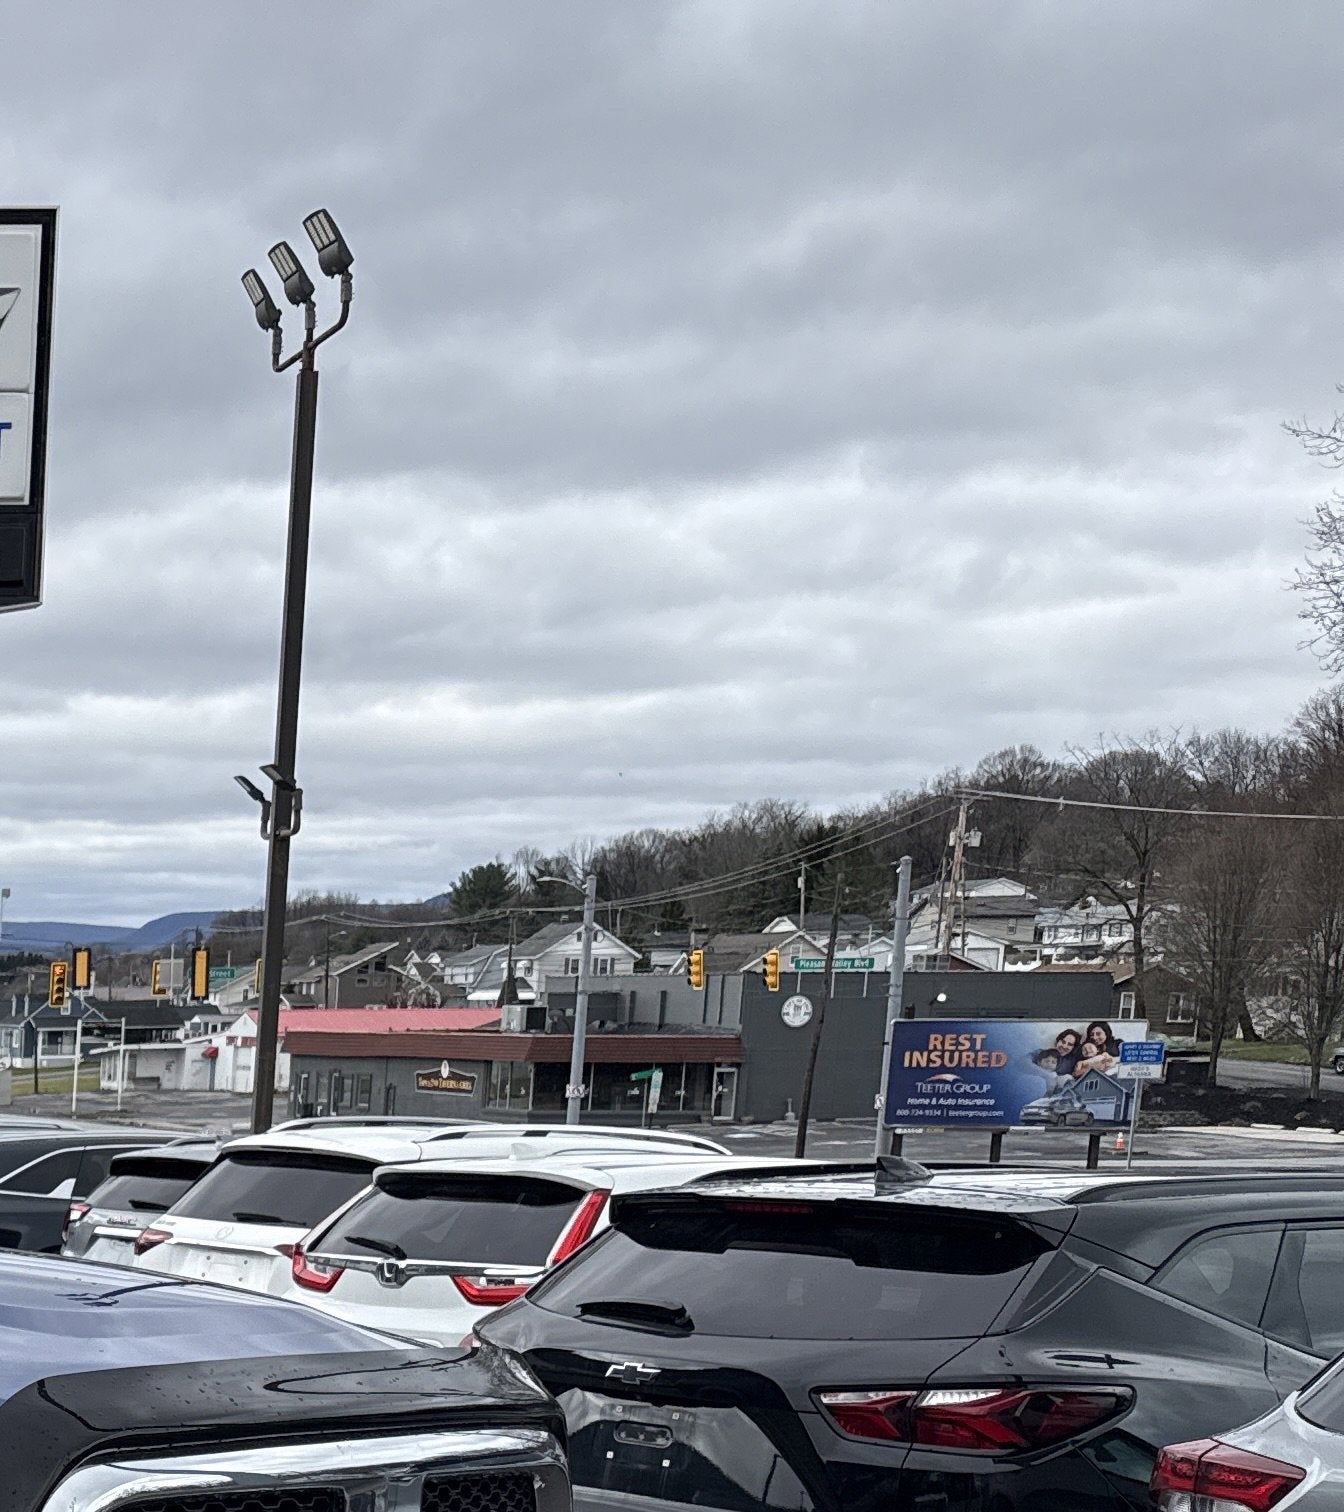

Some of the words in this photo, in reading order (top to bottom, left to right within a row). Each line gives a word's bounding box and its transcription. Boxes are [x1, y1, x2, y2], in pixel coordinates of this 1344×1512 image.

[928, 1034, 986, 1050] REST
[903, 1051, 1007, 1068] INSURED
[915, 1082, 952, 1093] TEETER
[953, 1083, 991, 1093] GROUP
